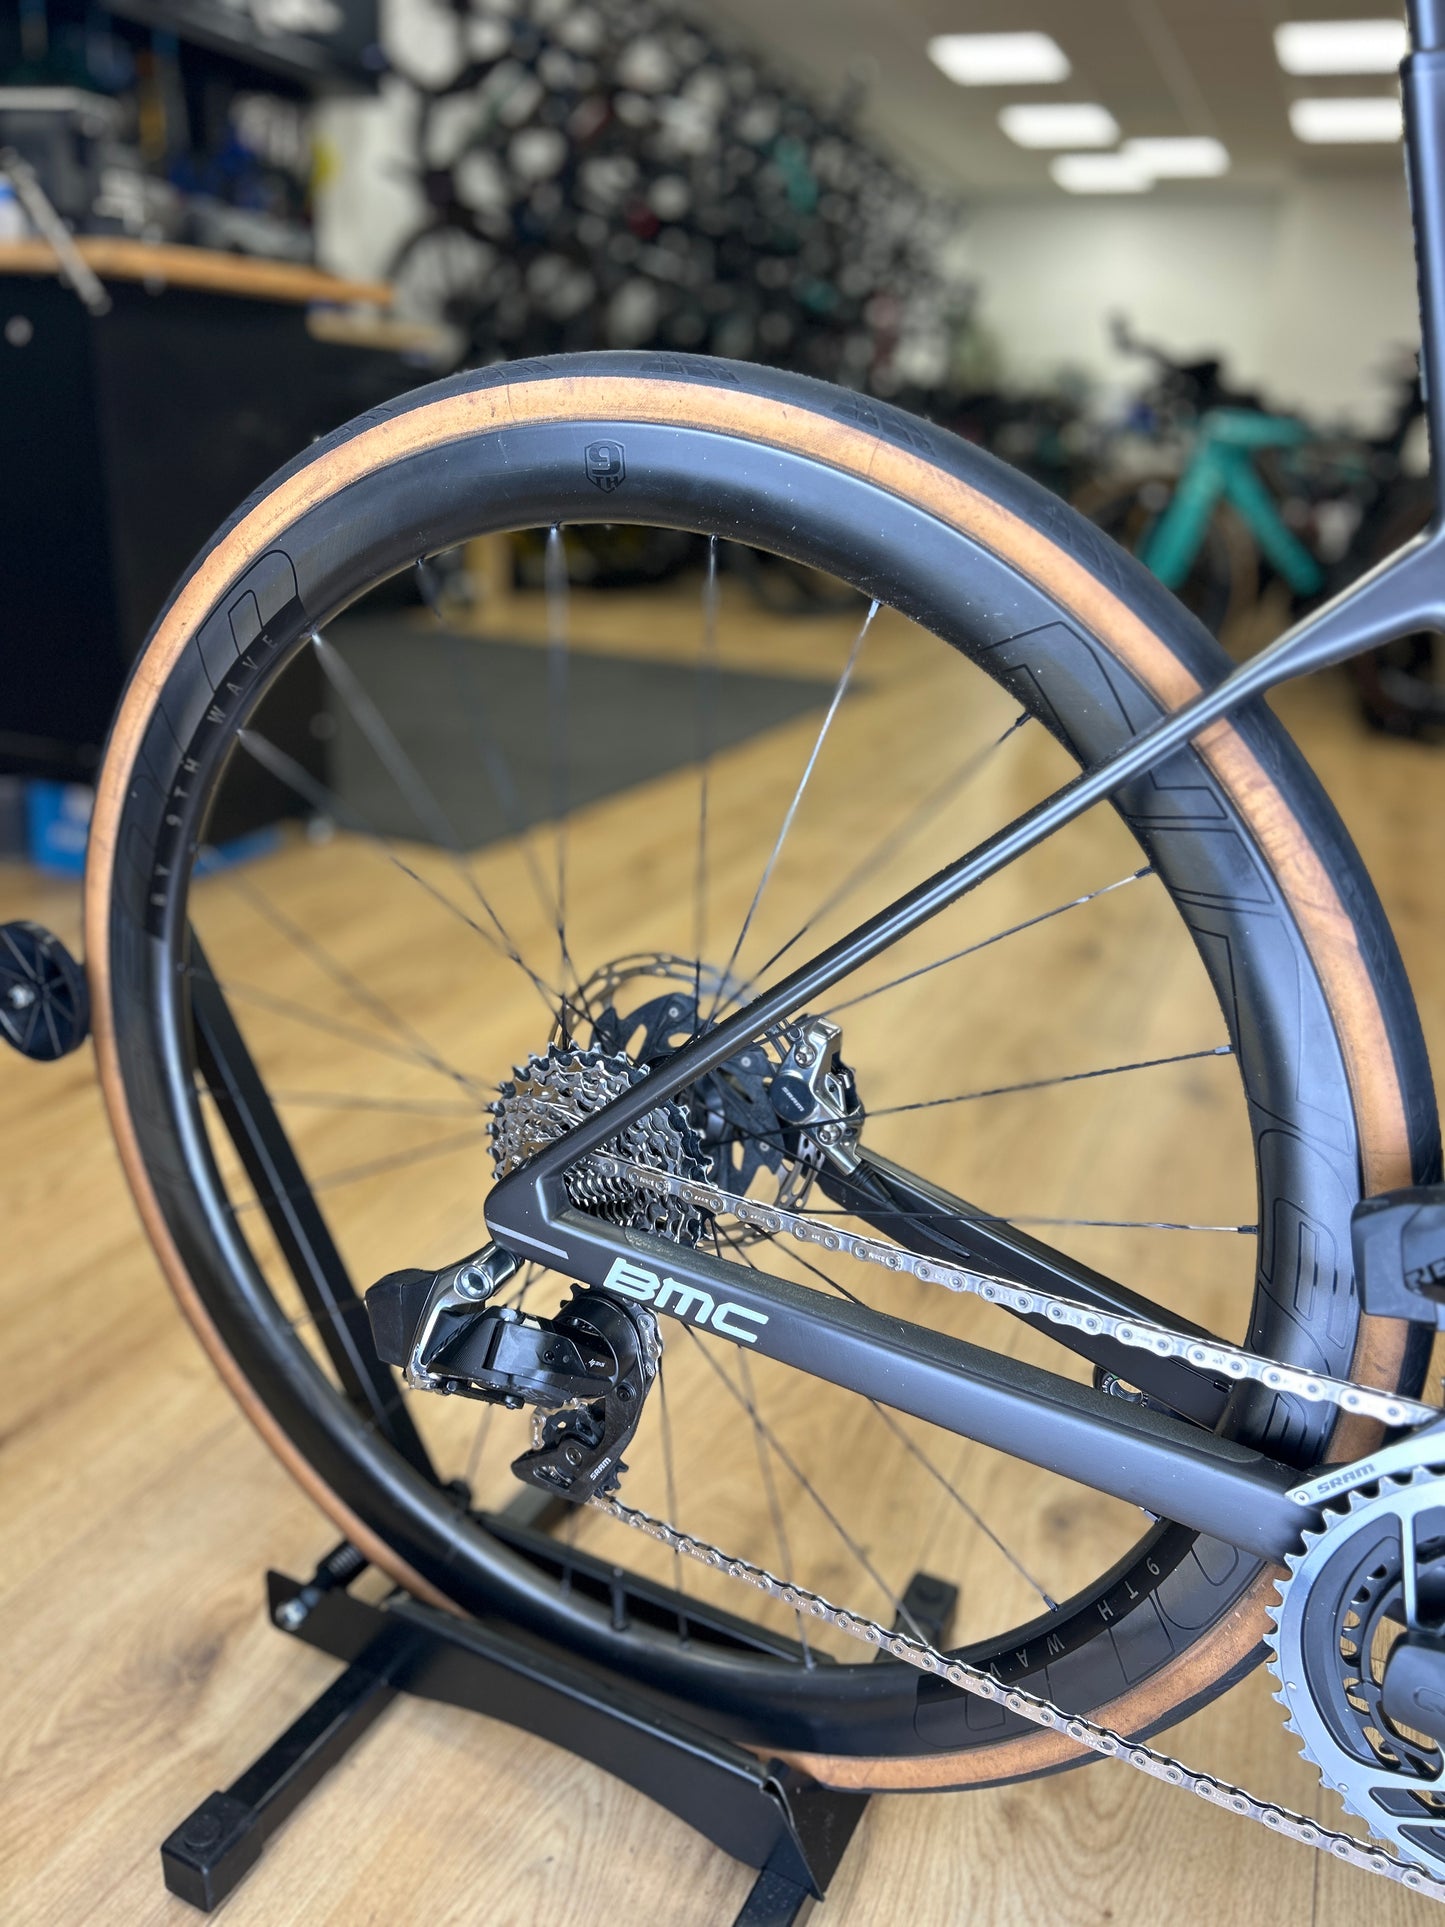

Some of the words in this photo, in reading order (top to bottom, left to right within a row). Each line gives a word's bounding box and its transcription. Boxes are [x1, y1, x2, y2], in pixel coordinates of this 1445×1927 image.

[588, 441, 621, 475] 9
[592, 475, 620, 489] TH
[165, 757, 202, 826] 9TH
[205, 632, 278, 726] WAVE
[781, 1086, 805, 1112] SRAM
[602, 1256, 769, 1344] BMC
[589, 1456, 612, 1481] SRAM
[1316, 1463, 1376, 1494] SRAM
[1096, 1556, 1161, 1622] 9TH
[989, 1632, 1066, 1679] WAV
